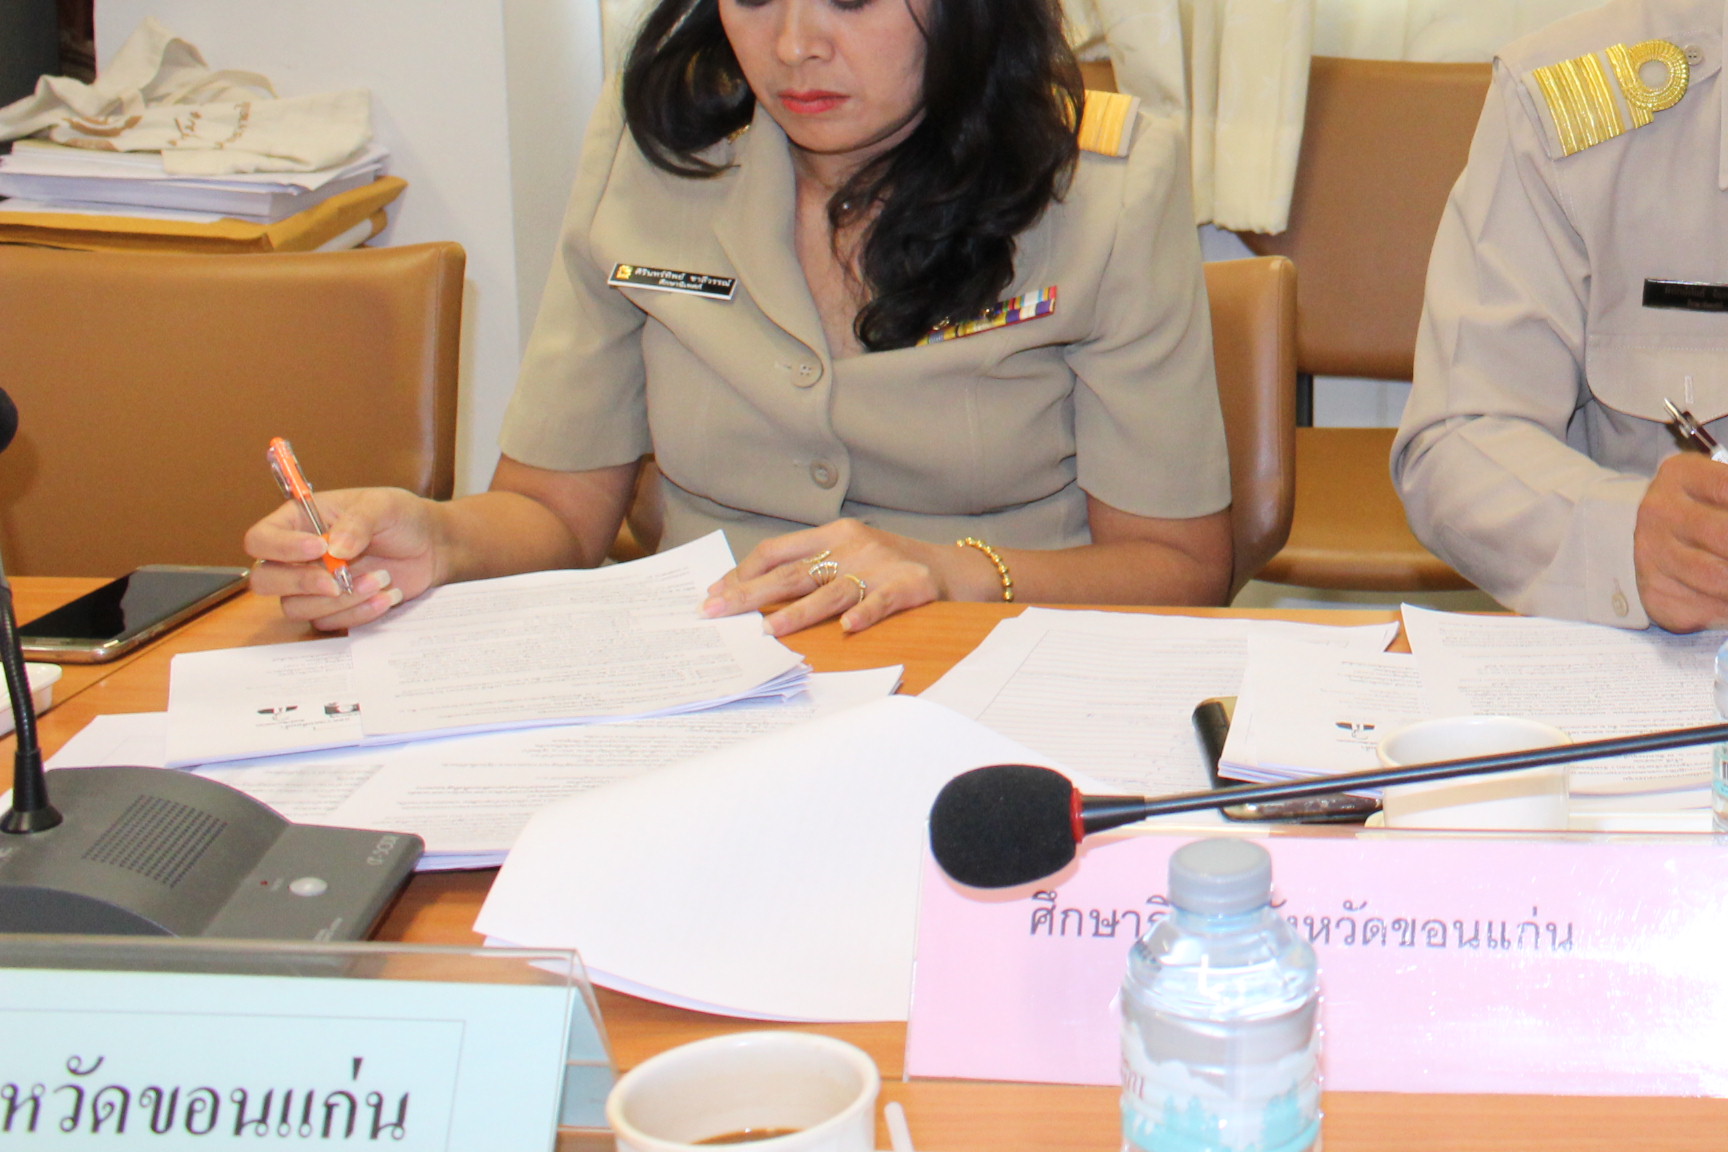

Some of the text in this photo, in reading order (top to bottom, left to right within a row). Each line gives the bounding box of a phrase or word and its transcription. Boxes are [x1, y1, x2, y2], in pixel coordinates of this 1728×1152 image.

[0, 1055, 410, 1141] หวัดขอนแก่น
